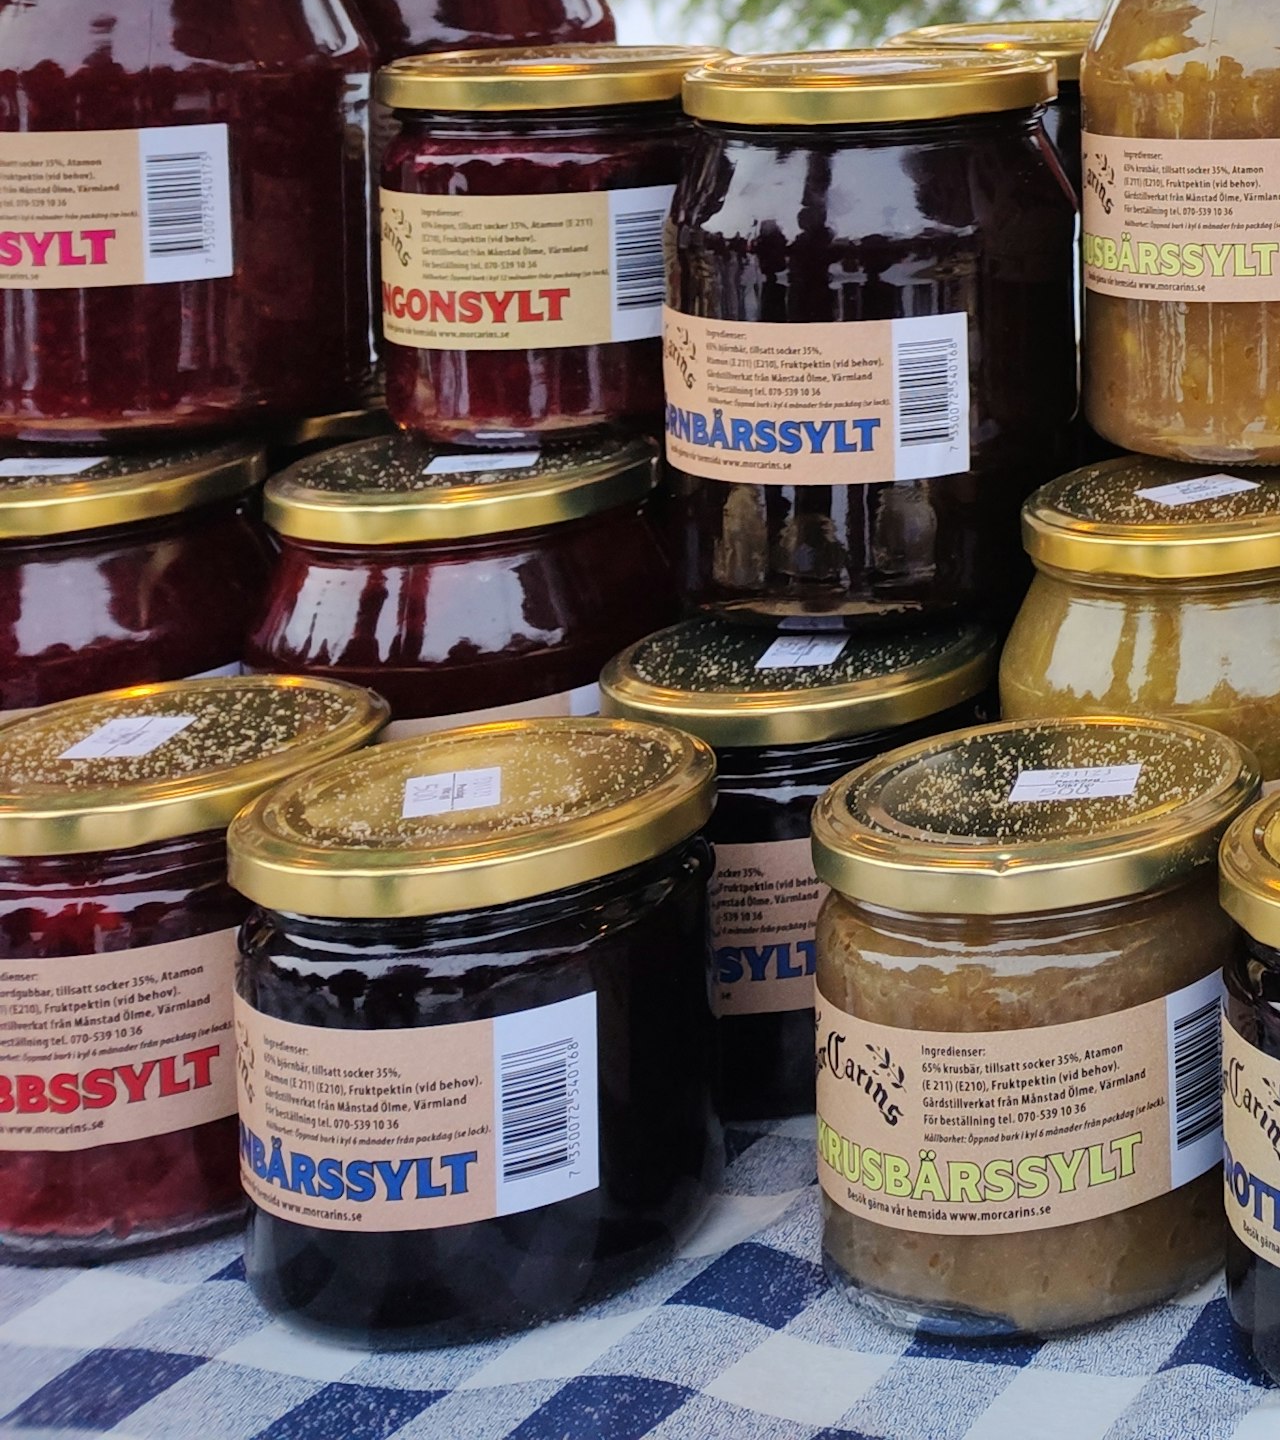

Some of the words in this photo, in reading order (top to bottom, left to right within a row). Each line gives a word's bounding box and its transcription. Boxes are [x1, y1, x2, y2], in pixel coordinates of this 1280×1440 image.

[921, 1045, 986, 1057] Ingredienser:
[922, 1062, 941, 1074] 65%
[943, 1064, 983, 1075] krusbär,
[985, 1061, 1020, 1073] tillsatt
[1022, 1059, 1055, 1071] socker
[1058, 1054, 1082, 1066] 35%,
[1084, 1044, 1123, 1061] Atamon
[827, 1031, 904, 1127] Carins
[923, 1093, 995, 1108] Gårdstillverkat
[998, 1094, 1019, 1106] från
[1021, 1091, 1066, 1105] Månstad
[1068, 1086, 1097, 1099] Ölme,
[1100, 1069, 1146, 1092] Värmland
[933, 1080, 953, 1092] 211)
[955, 1080, 989, 1093] (E210),
[991, 1075, 1056, 1091] Fruktpektin
[1059, 1071, 1079, 1084] (vid
[1081, 1061, 1120, 1078] behov).
[924, 1114, 937, 1125] För
[940, 1111, 995, 1127] beställning
[998, 1112, 1015, 1124] tel.
[1018, 1105, 1057, 1123] 070-539
[1061, 1106, 1072, 1117] 10
[1074, 1103, 1086, 1115] 36
[924, 1132, 967, 1145] Hållbarhet:
[968, 1132, 999, 1146] Öppnad
[1001, 1131, 1019, 1142] burk
[1026, 1129, 1038, 1141] kyl
[1039, 1129, 1044, 1138] 6
[1045, 1123, 1082, 1137] månader
[1083, 1118, 1101, 1130] från
[1102, 1108, 1135, 1126] packdag
[817, 1111, 1144, 1202] KRUSBÄRSSYLT
[847, 1187, 866, 1207] Besök
[867, 1197, 889, 1213] gärna
[890, 1204, 906, 1218] vår
[907, 1206, 947, 1221] hemsida
[950, 1204, 1052, 1222] www.morcarins.se
